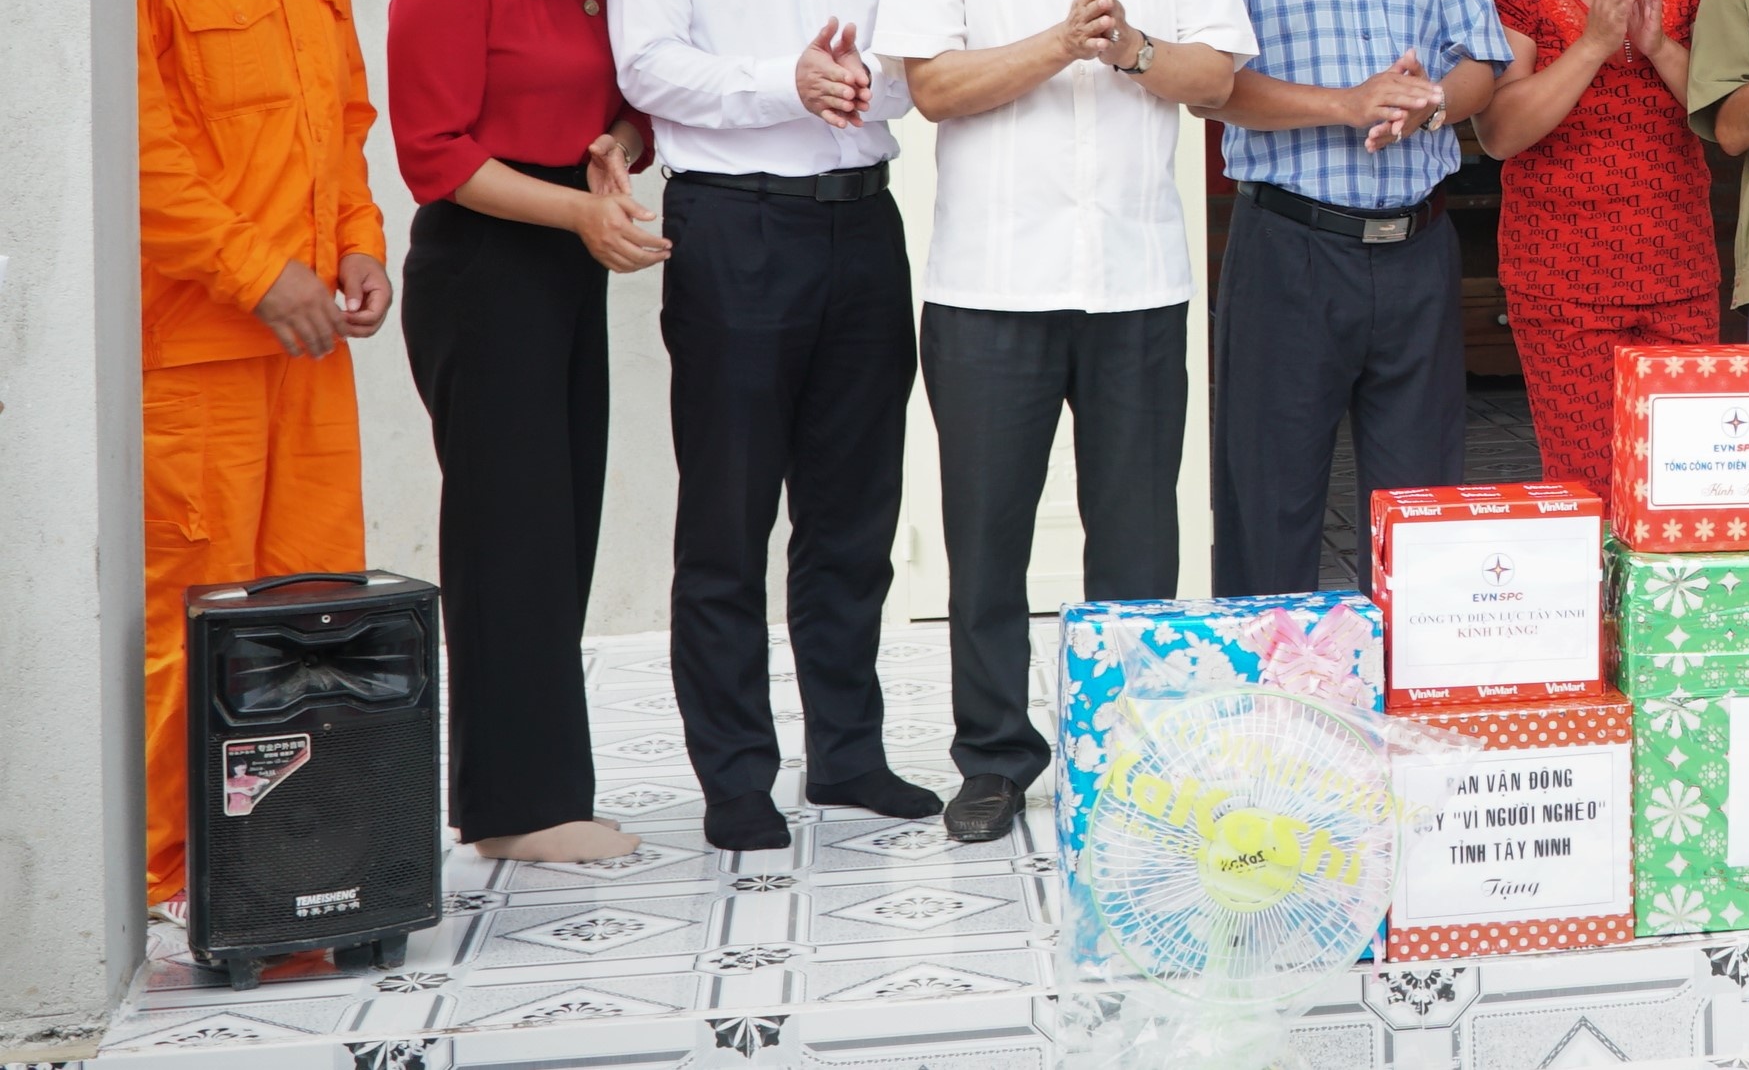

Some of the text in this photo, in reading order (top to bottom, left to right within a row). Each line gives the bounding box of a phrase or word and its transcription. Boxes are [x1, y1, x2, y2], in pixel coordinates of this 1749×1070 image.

[1716, 461, 1726, 470] TY
[1401, 506, 1442, 518] VinMart
[1470, 504, 1510, 516] VinMart
[1538, 502, 1578, 514] VinMart
[1410, 612, 1444, 625] CÔNG
[1449, 614, 1464, 624] TY
[1556, 610, 1585, 619] NINH
[1408, 688, 1450, 700] VinMart
[1478, 685, 1518, 698] VinMart
[1546, 682, 1586, 694] VinMart
[1486, 769, 1520, 797] VẬN
[1528, 766, 1573, 794] ĐỘNG
[1486, 802, 1536, 828] NGƯỜI
[1450, 838, 1571, 864] TỈNH TÂY NINH
[1481, 878, 1540, 900] Tặng
